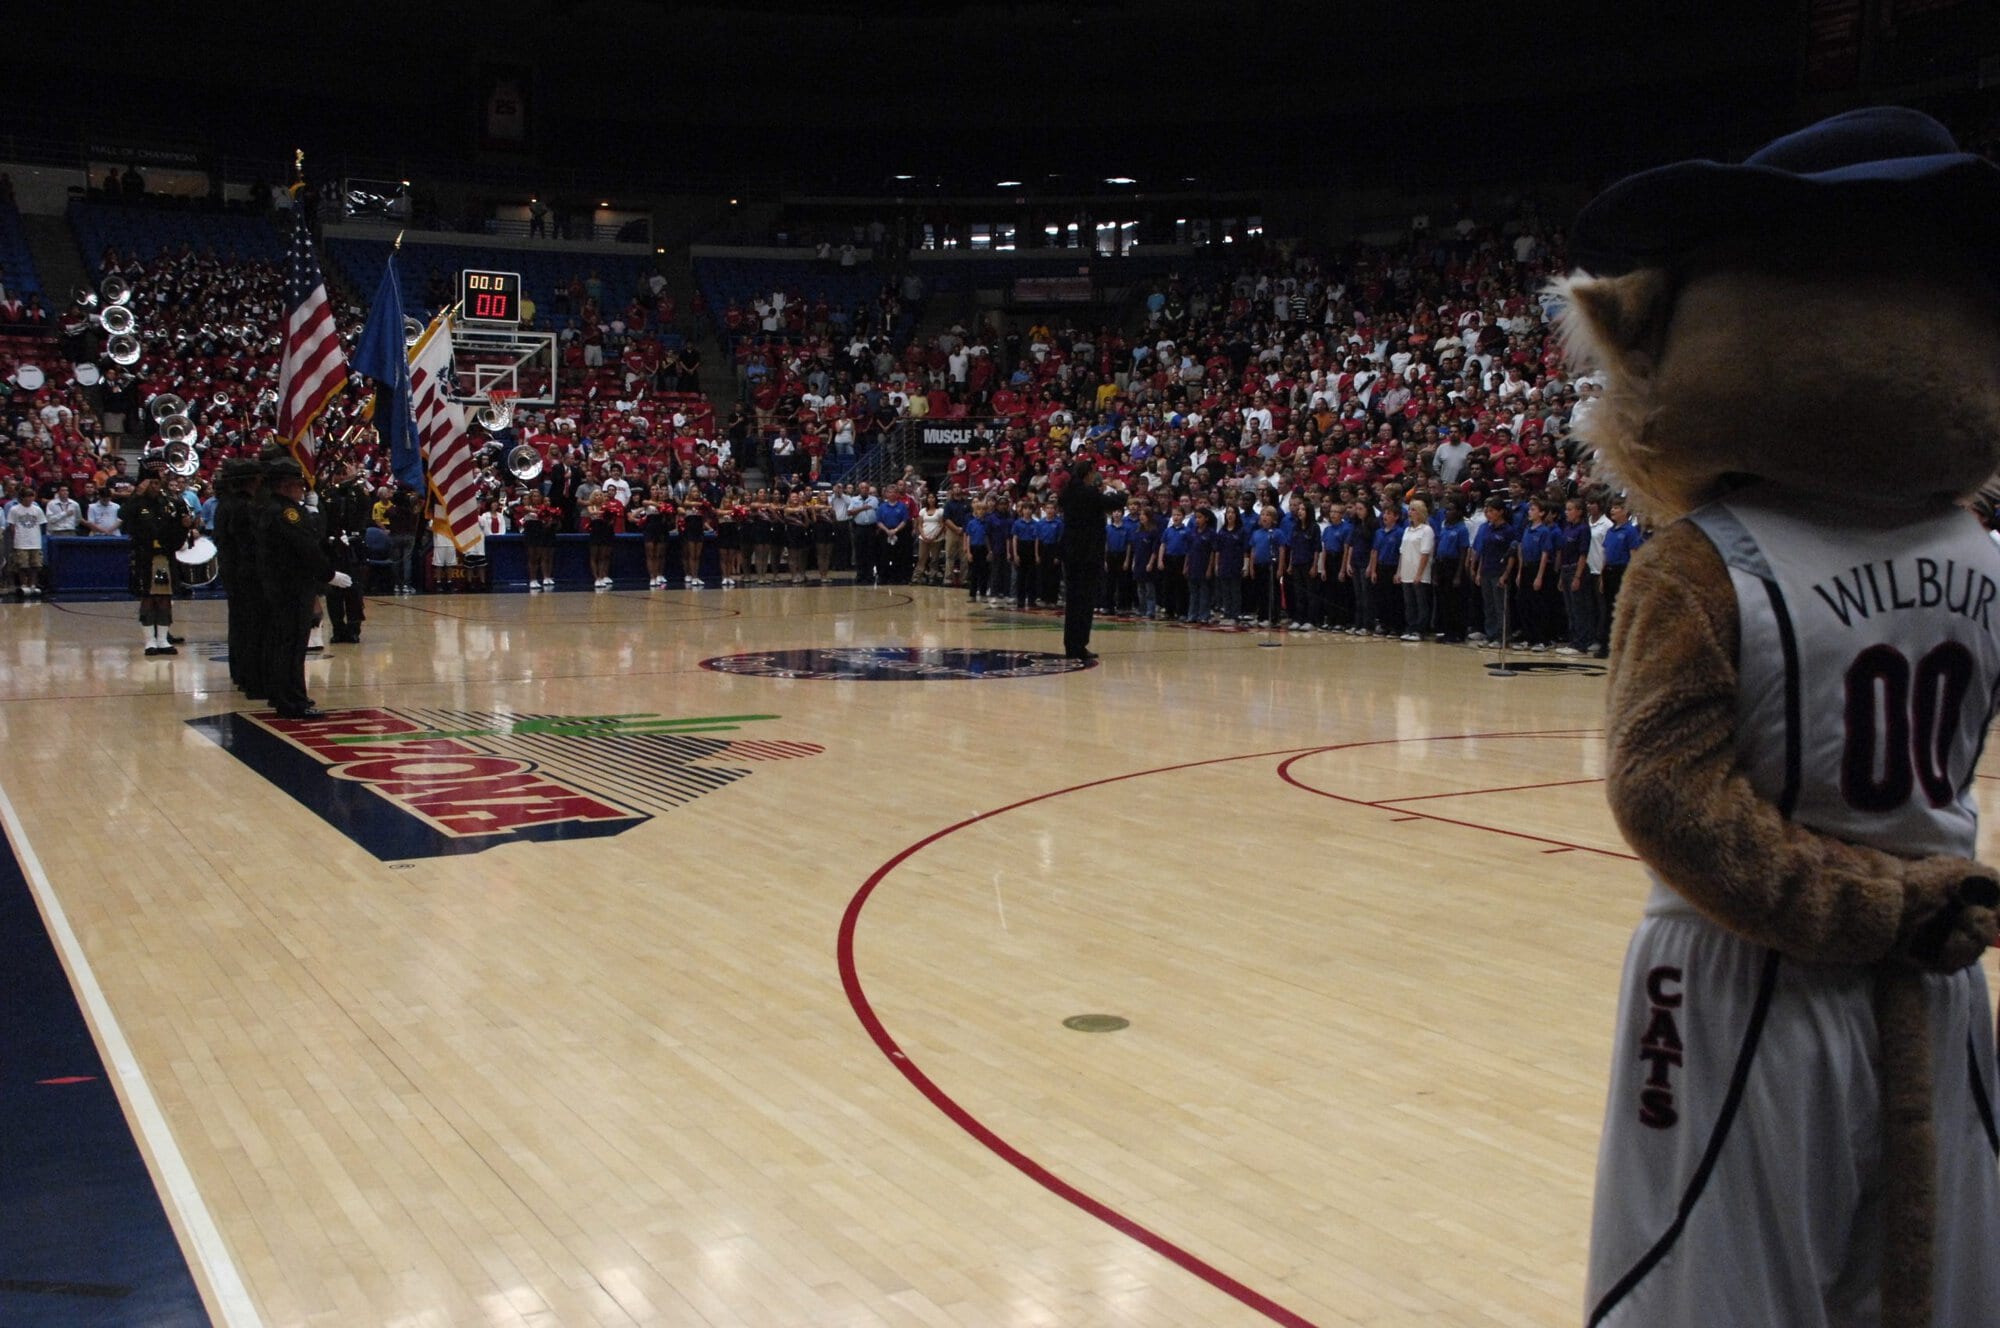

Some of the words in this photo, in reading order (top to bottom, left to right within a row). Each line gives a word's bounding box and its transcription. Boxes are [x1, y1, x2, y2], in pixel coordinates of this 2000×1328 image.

[469, 274, 504, 291] 00.0
[475, 293, 507, 318] 00
[923, 428, 972, 444] MUSCLE
[1812, 556, 1998, 632] WILBUR
[1840, 640, 1974, 813] 00
[1638, 965, 1683, 1131] CATS
